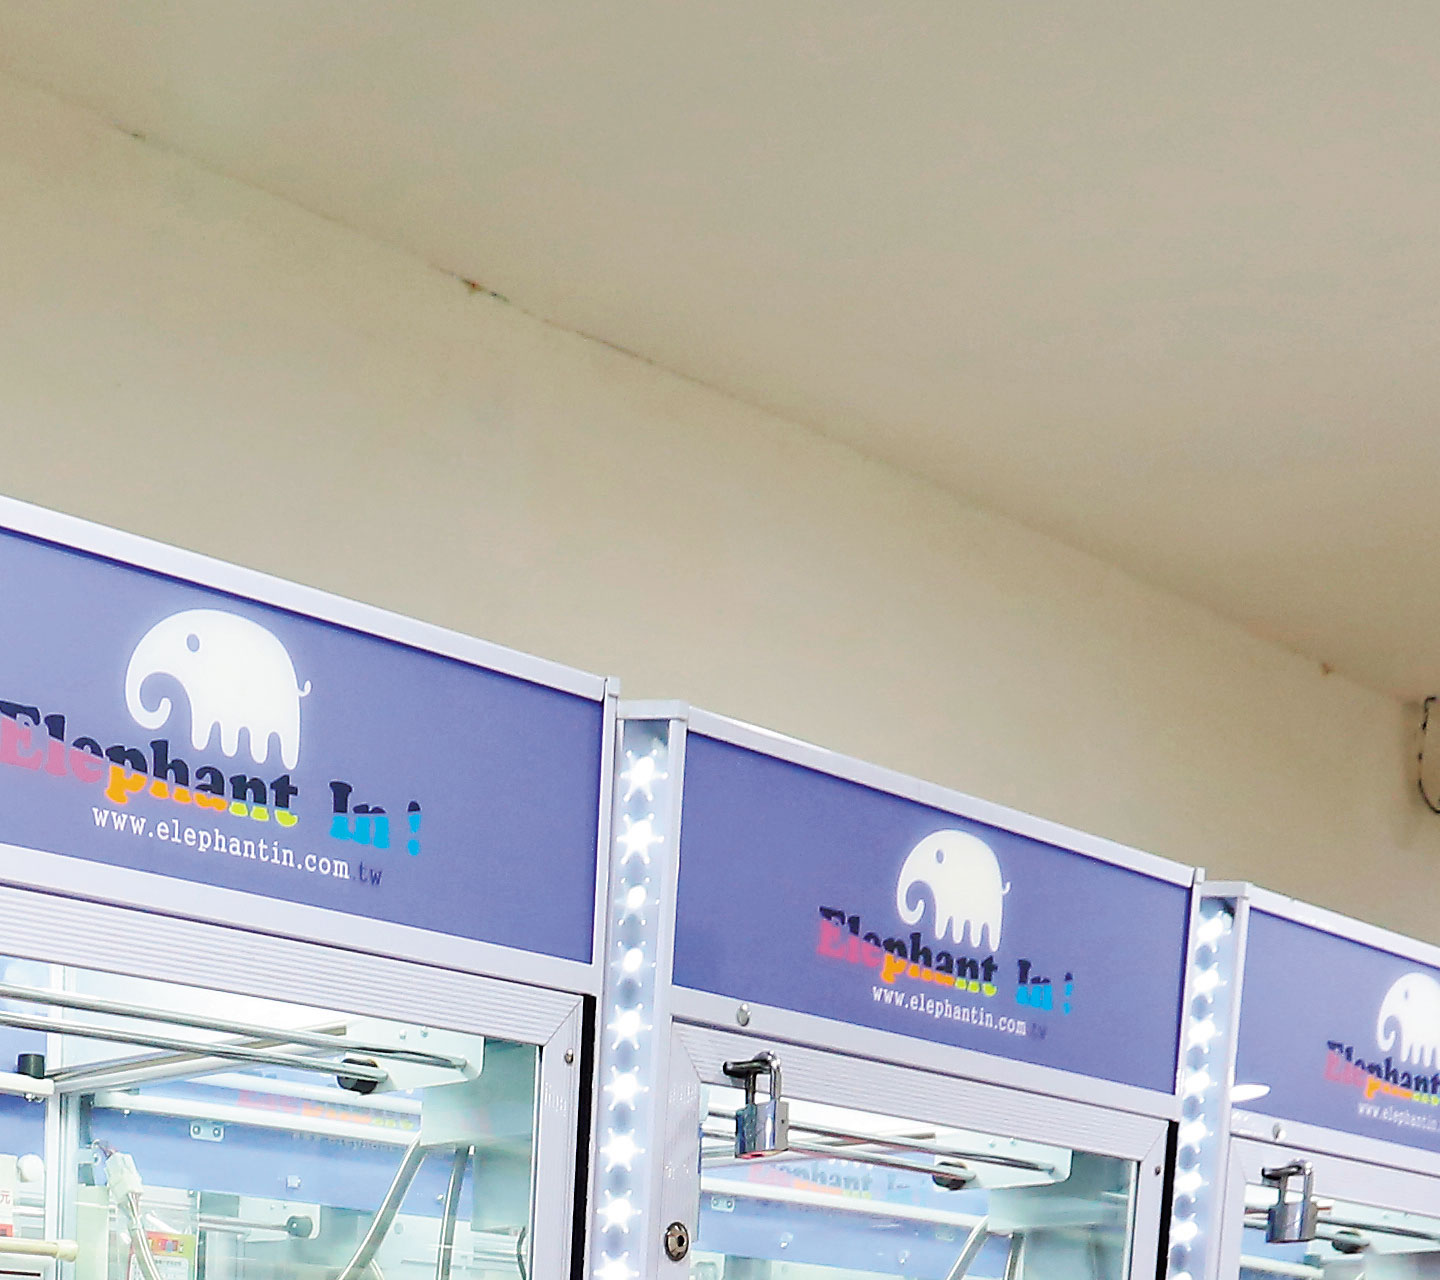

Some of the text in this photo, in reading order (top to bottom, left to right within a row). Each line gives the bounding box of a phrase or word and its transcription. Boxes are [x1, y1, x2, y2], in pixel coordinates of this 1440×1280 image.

[92, 805, 383, 886] www.elephantin.com.tw
[816, 905, 998, 997] Elephant
[0, 1191, 11, 1204] 元
